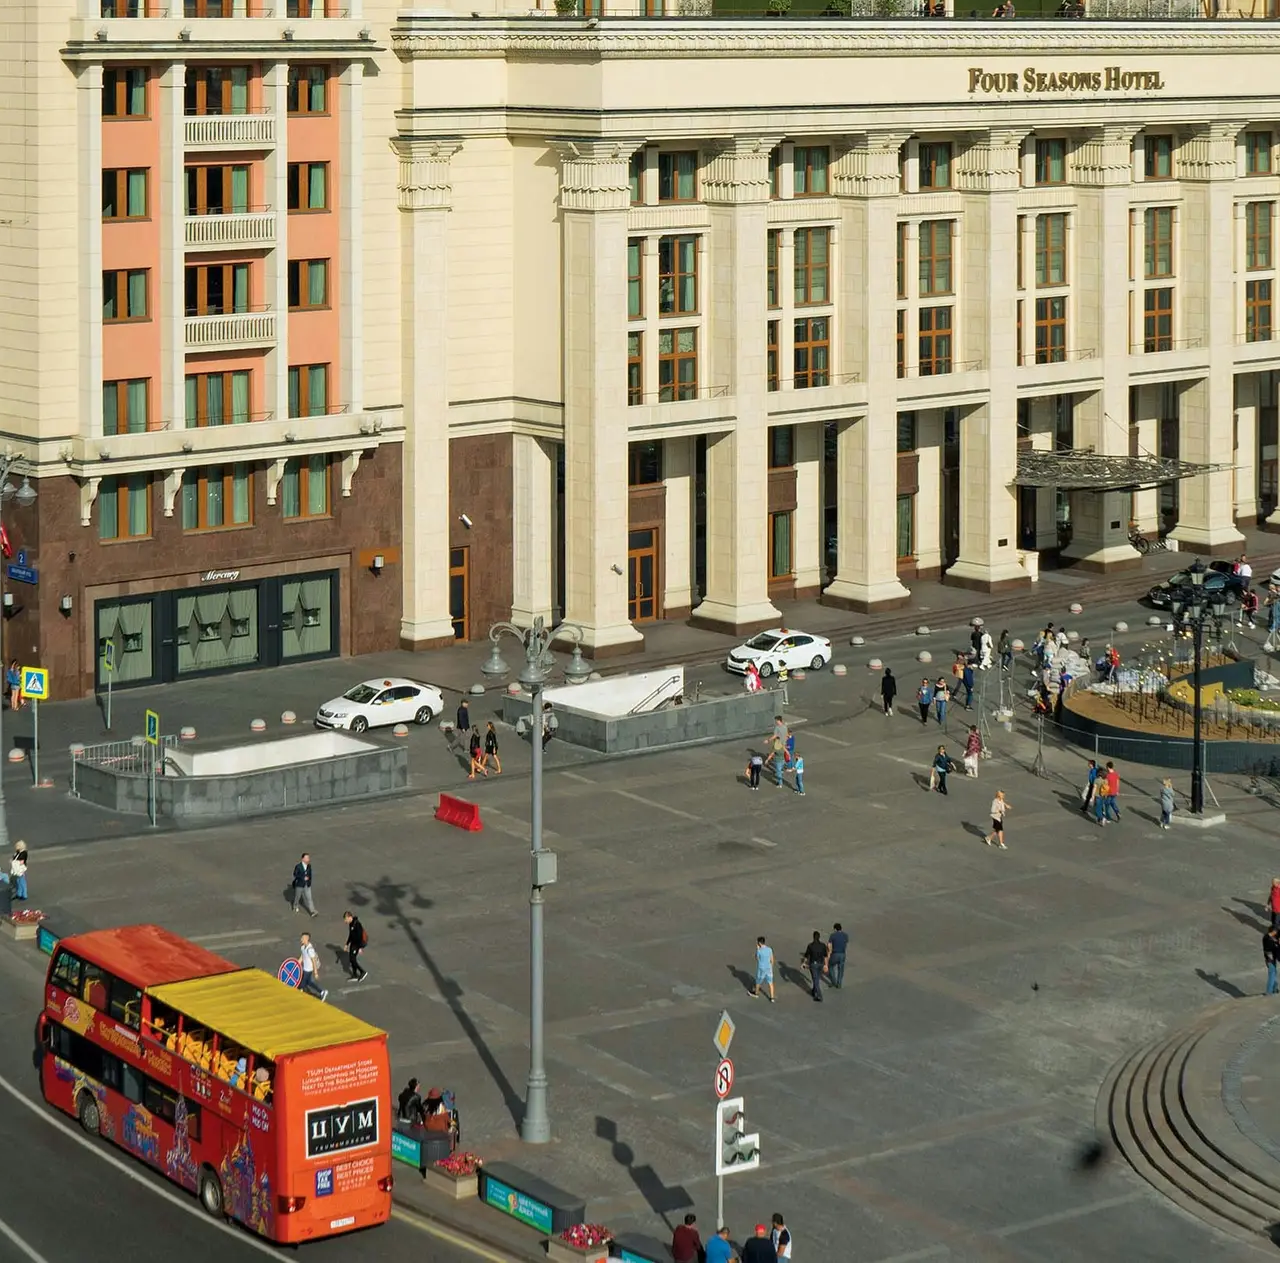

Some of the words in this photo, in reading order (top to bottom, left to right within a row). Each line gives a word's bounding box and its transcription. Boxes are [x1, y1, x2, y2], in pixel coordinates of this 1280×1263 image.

[968, 68, 1019, 93] FOUR
[1023, 67, 1101, 93] SEASONS
[1104, 66, 1165, 91] HOTEL
[201, 570, 239, 581] Mercury
